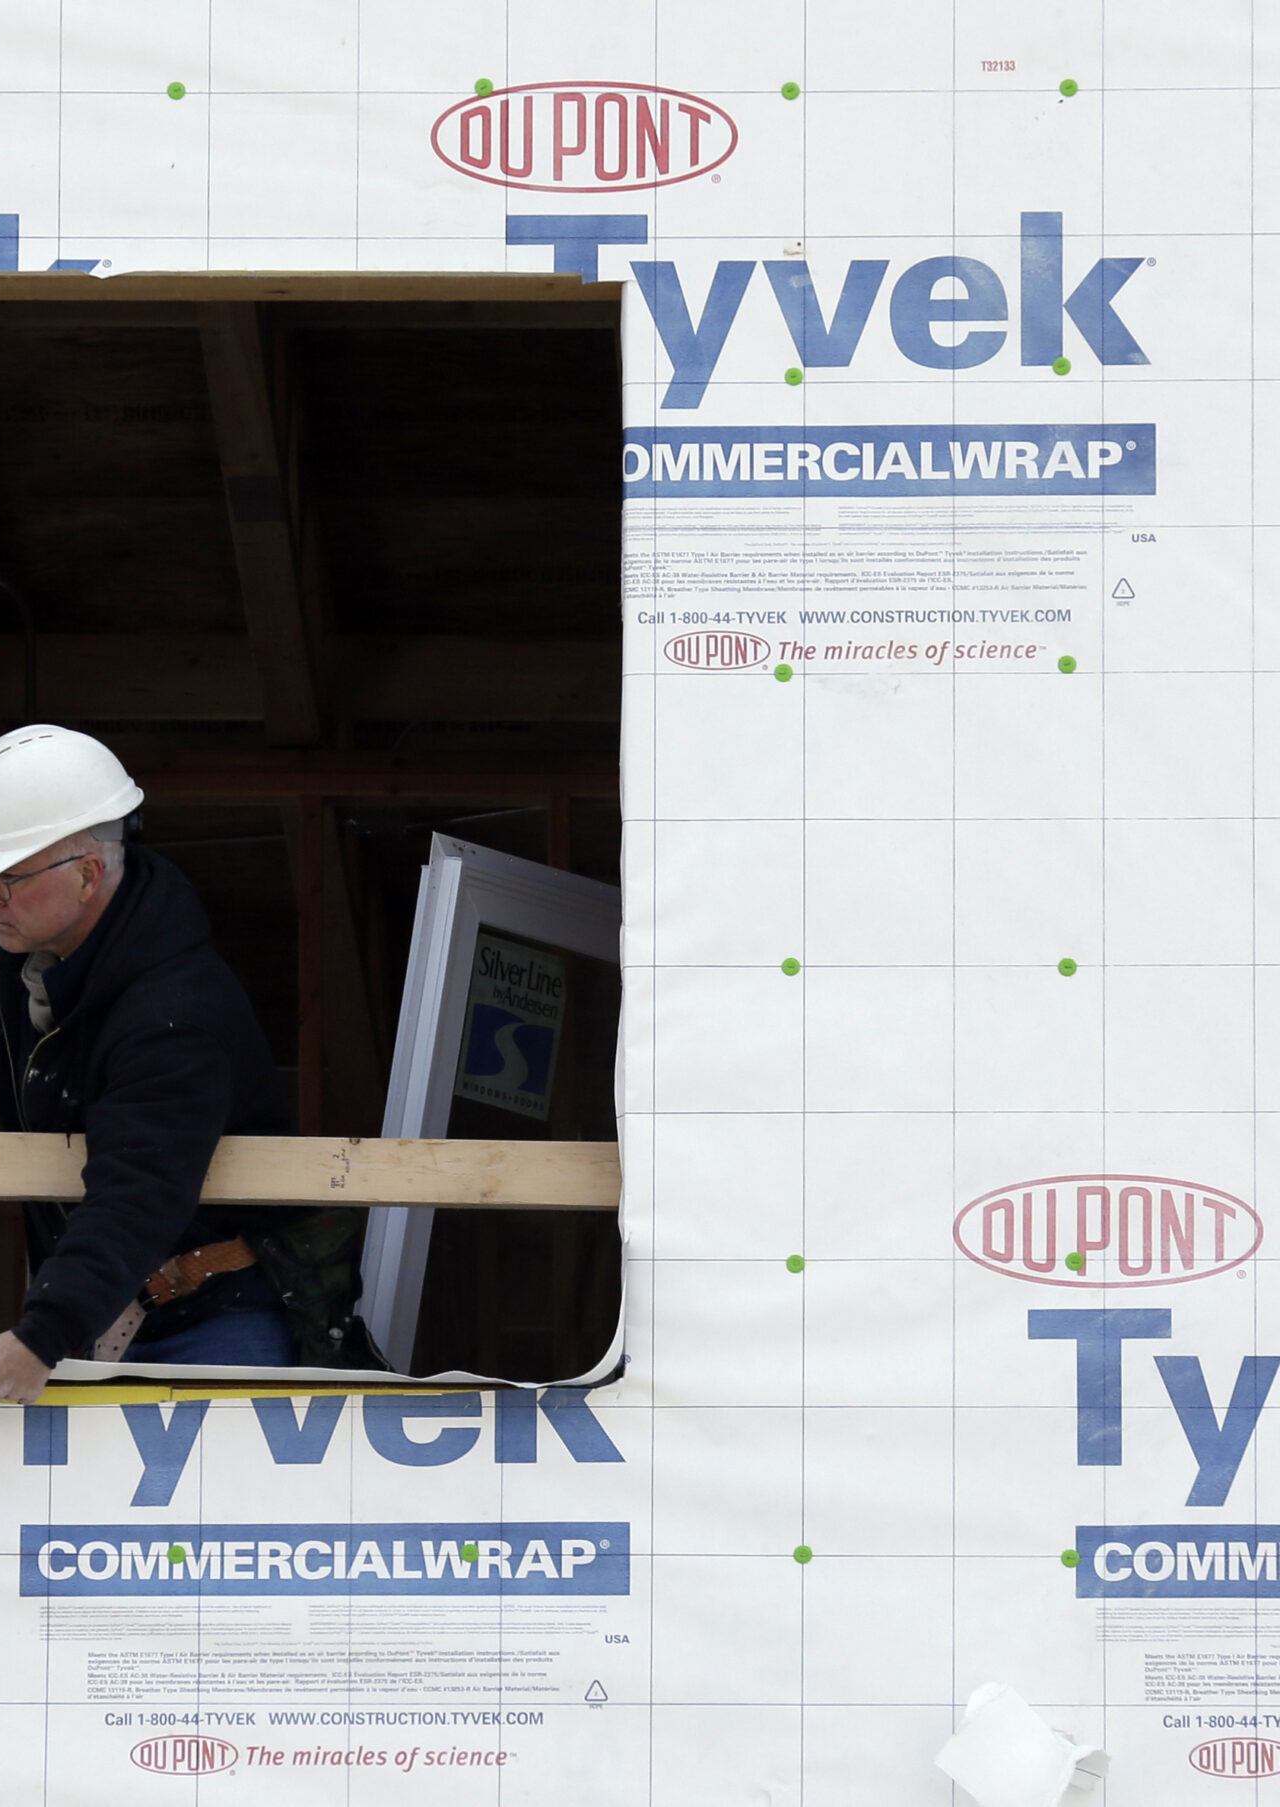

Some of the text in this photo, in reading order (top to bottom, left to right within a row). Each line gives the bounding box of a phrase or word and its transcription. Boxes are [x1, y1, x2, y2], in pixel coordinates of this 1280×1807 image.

[981, 60, 1016, 72] T32133
[1131, 533, 1157, 543] USA
[637, 608, 1071, 624] Call 1-800-44-TYVEK WWW.CONSTRUCTION.TYVEK.COM
[778, 641, 816, 660] The
[824, 640, 918, 660] miracles
[925, 641, 951, 665] of
[503, 986, 558, 1019] Andersen
[1028, 1308, 1280, 1507] Ty
[23, 1387, 627, 1507] yvek
[1093, 1541, 1278, 1582] COMM
[604, 1634, 630, 1644] USA
[105, 1711, 543, 1726] Call 1-800-44-TYVEK WWW.CONSTRUCTION.TYVEK.COM
[1162, 1715, 1280, 1729] Call 1-800-44-TY
[246, 1746, 284, 1766] The
[292, 1746, 388, 1766] miracles
[394, 1747, 420, 1772] of
